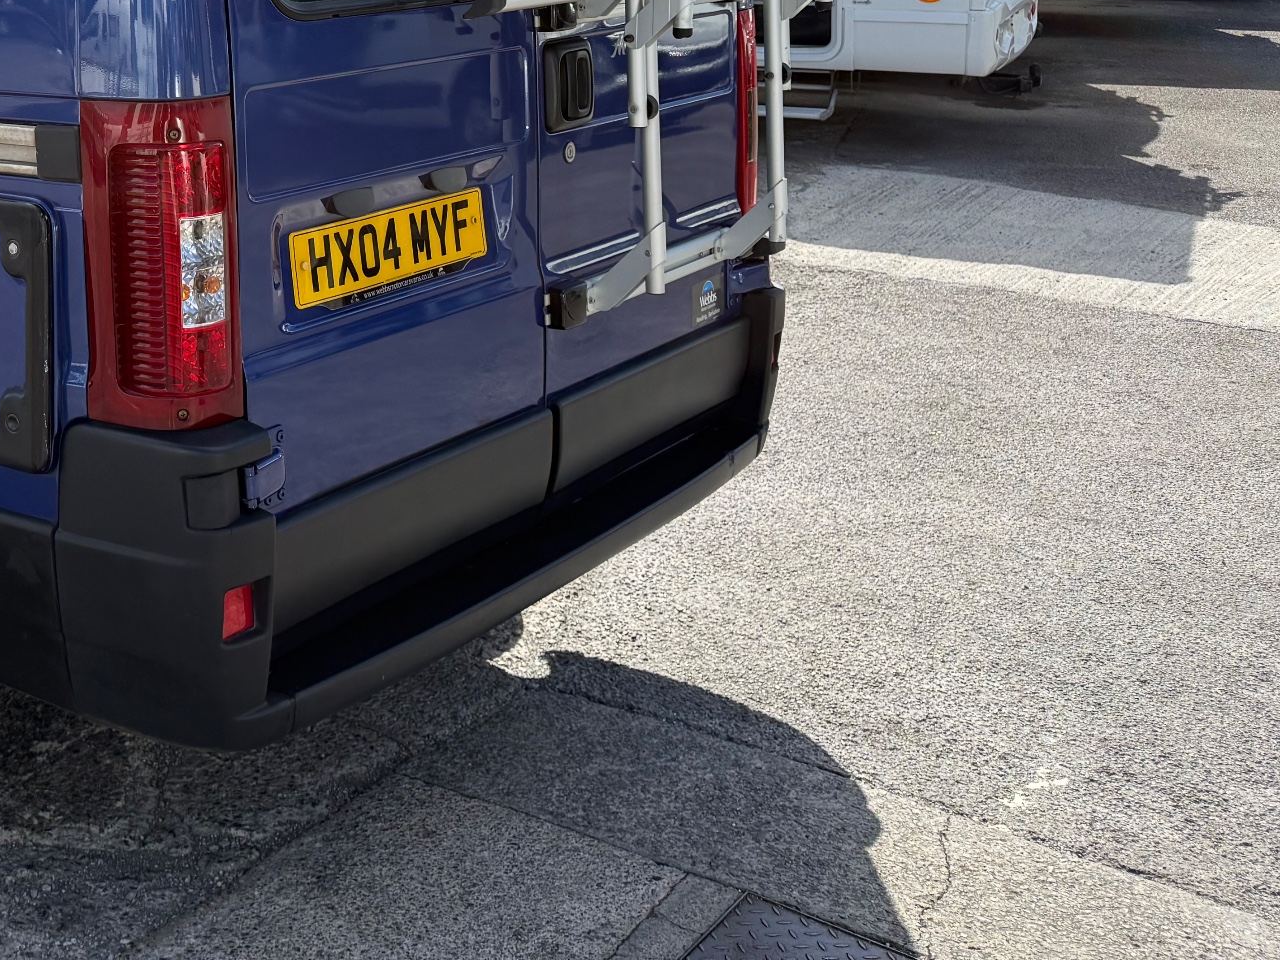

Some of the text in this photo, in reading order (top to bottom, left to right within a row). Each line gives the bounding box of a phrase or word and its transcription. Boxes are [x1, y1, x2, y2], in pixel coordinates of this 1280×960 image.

[308, 199, 469, 293] HX04 MYF
[700, 291, 717, 307] Webbs
